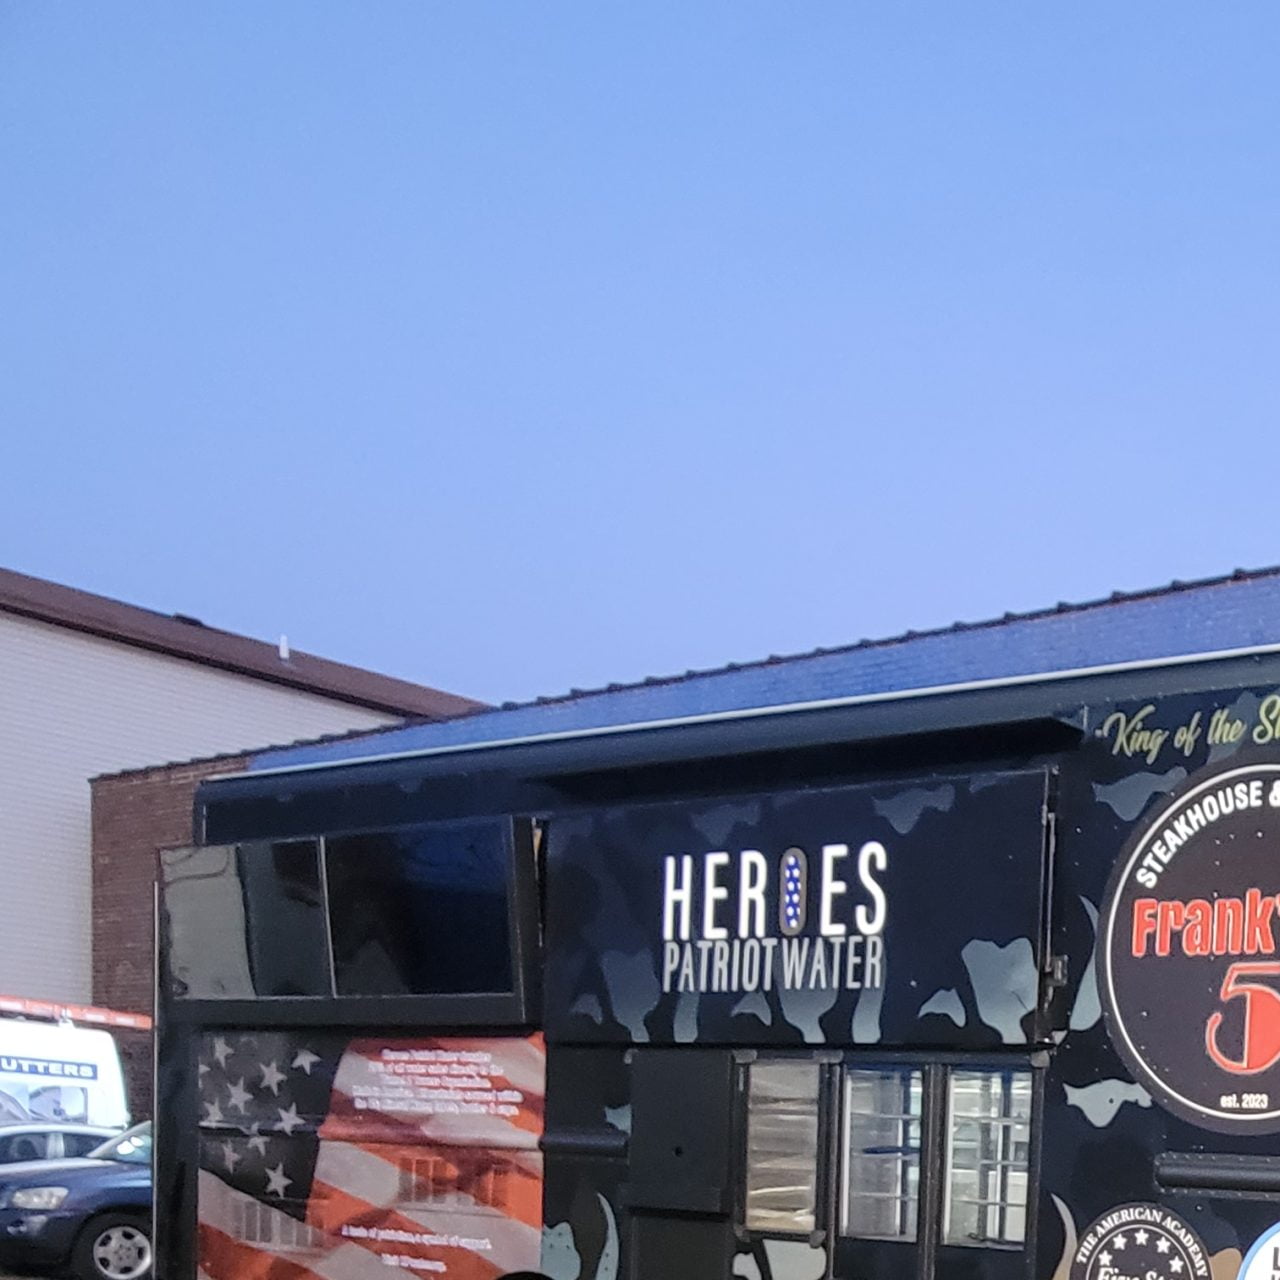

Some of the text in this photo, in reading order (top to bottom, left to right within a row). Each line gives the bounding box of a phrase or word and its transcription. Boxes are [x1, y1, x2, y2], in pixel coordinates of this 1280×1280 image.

[1100, 705, 1168, 765] King
[1174, 711, 1201, 757] of
[1208, 707, 1246, 745] the
[1136, 779, 1264, 889] STEAKHOUSE
[663, 935, 883, 993] PATRIOT WATER
[1220, 1093, 1268, 1110] est. 2023
[1076, 1207, 1209, 1277] THE AMERICAN ACADEMY
